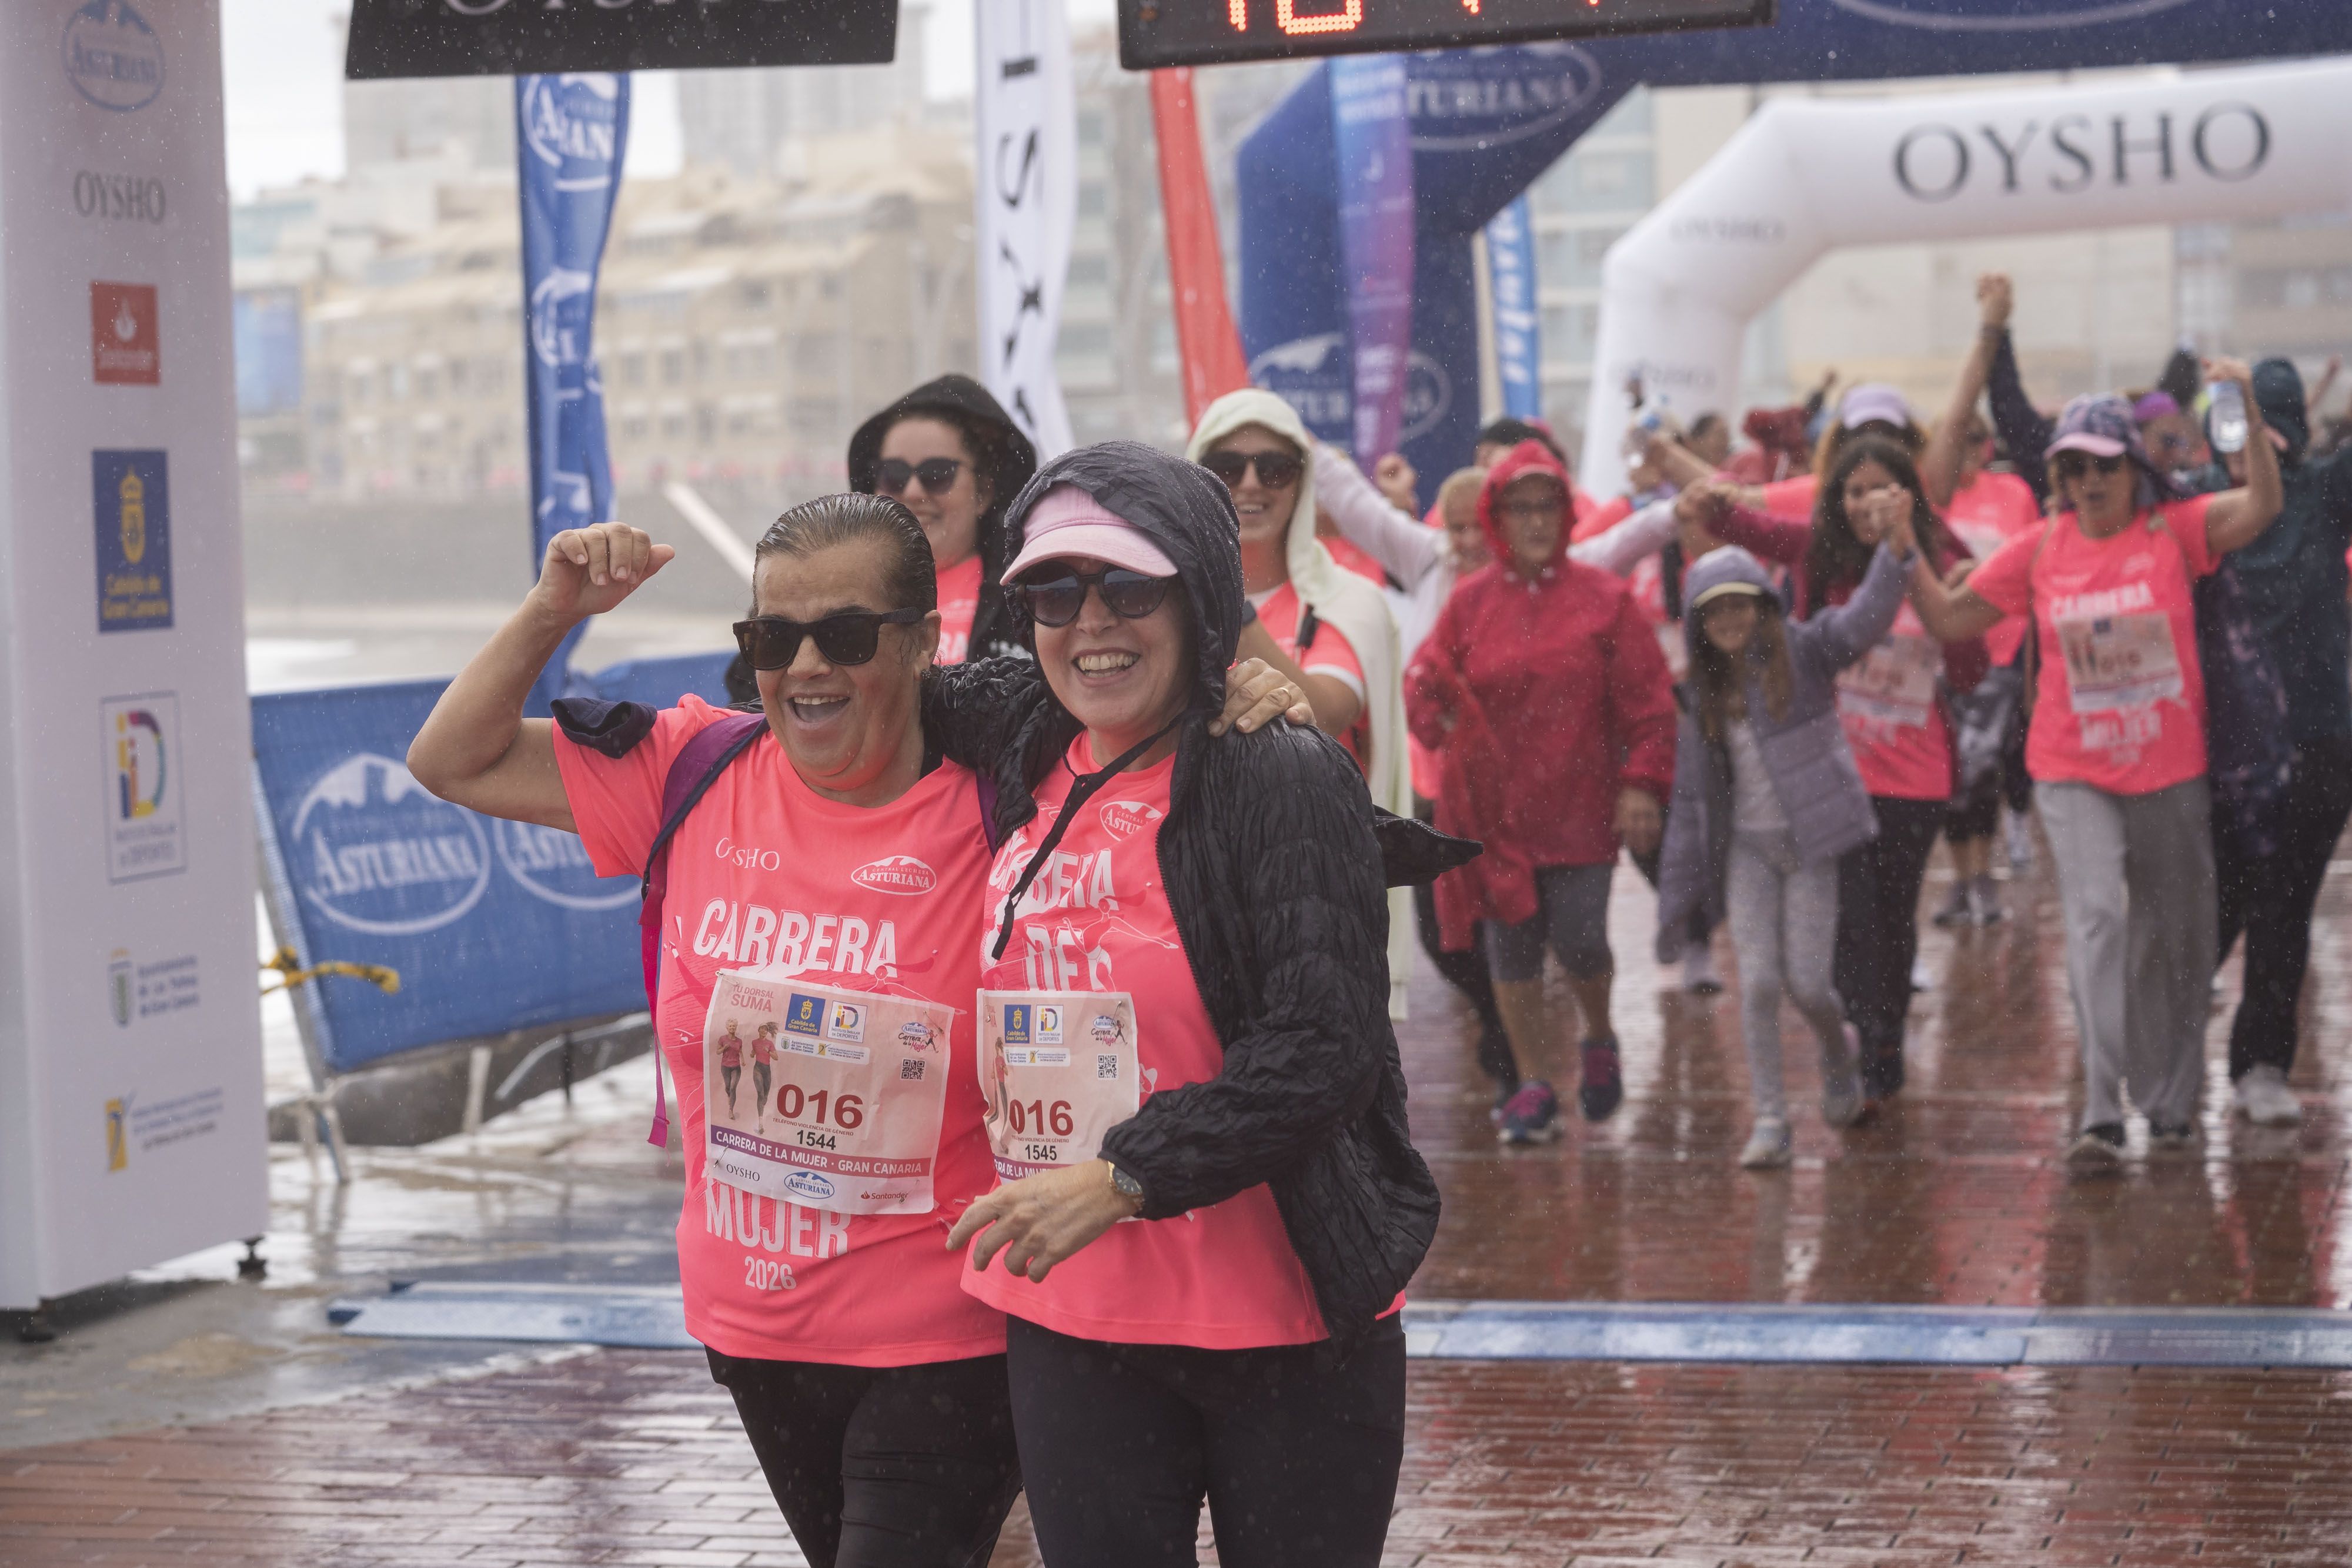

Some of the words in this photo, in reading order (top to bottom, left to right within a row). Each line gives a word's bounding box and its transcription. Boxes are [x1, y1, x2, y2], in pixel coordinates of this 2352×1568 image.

[1893, 101, 2273, 203] OYSHO
[74, 170, 166, 225] OYSHO
[310, 825, 478, 896] ASTURIANA
[856, 870, 930, 888] ASTURIANA
[693, 897, 898, 979] CARRERA
[733, 984, 743, 993] TU
[744, 987, 774, 998] DORSAL
[731, 994, 771, 1012] SUMA
[898, 1032, 921, 1042] Carrera
[911, 1040, 927, 1052] Mujer
[777, 1084, 863, 1129] 016
[773, 1118, 797, 1126] TELÉFONO
[798, 1123, 824, 1132] VIOLENCIA
[1009, 1099, 1073, 1136] 016
[797, 1129, 836, 1151] 1544
[716, 1131, 756, 1153] CARRERA
[760, 1143, 772, 1156] DE
[775, 1147, 787, 1161] LA
[791, 1151, 827, 1168] MUJER
[838, 1159, 870, 1173] GRAN
[873, 1162, 922, 1175] CANARIA
[1025, 1144, 1057, 1161] 1545
[726, 1164, 760, 1182] OYSHO
[1006, 1164, 1014, 1176] DE
[1014, 1166, 1024, 1178] LA
[788, 1178, 830, 1195] ASTURIANA
[871, 1191, 908, 1200] Santander
[704, 1178, 851, 1259] MUJER
[744, 1256, 797, 1290] 2026
